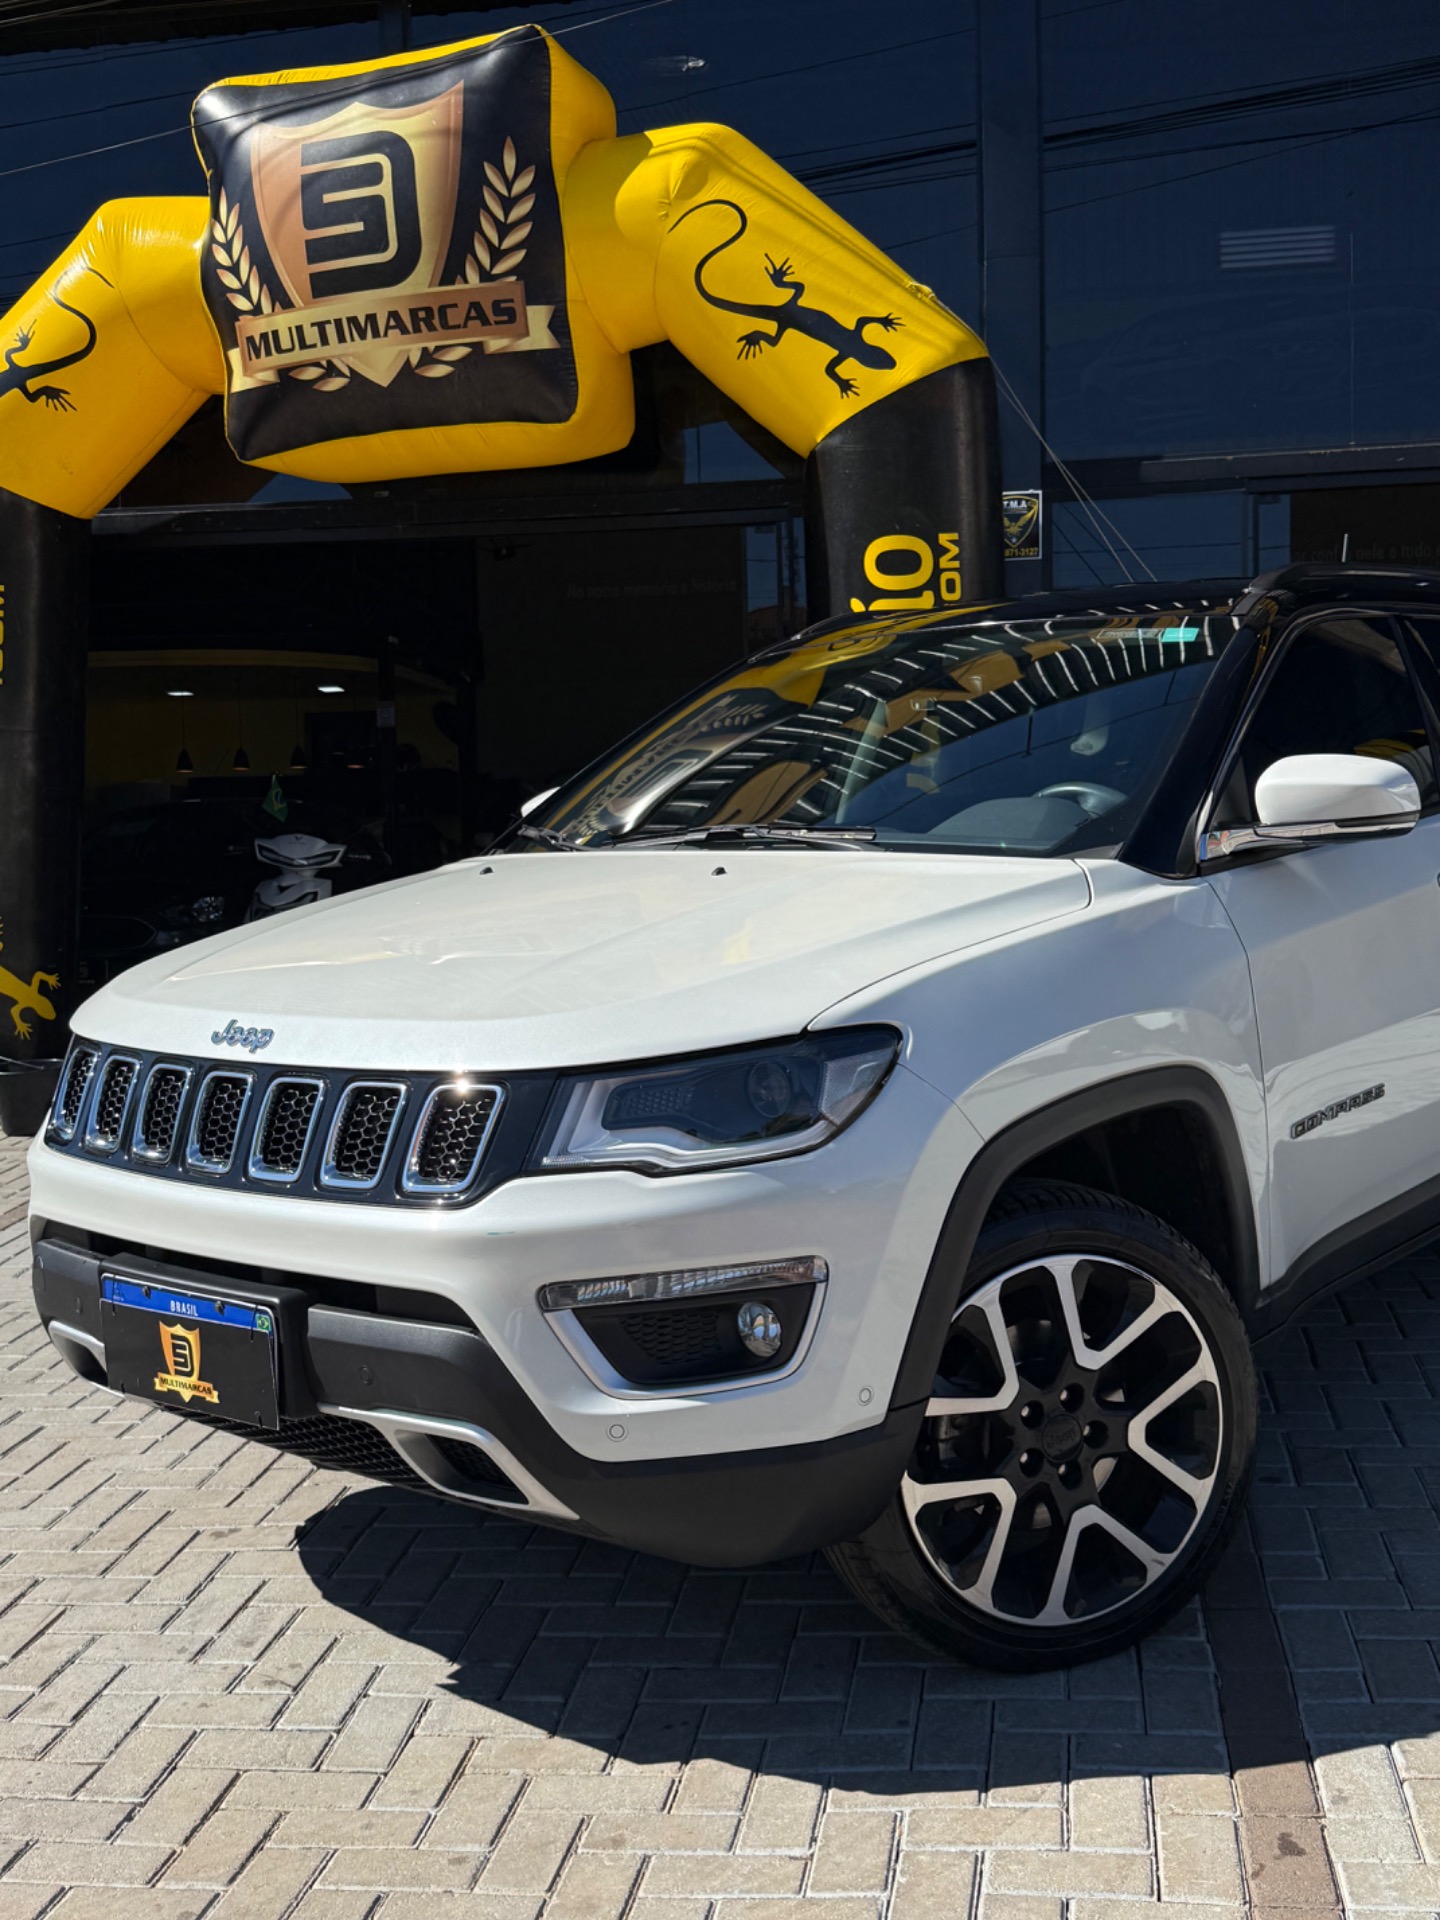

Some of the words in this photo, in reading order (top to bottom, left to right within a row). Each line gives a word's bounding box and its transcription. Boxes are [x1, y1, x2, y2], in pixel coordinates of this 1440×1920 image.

[245, 299, 517, 362] MULTIMARCAS
[211, 1019, 275, 1055] Jeep
[1290, 1083, 1386, 1139] COMPASS
[170, 1300, 199, 1316] BRASIL
[159, 1376, 212, 1395] MULTIMARCAS
